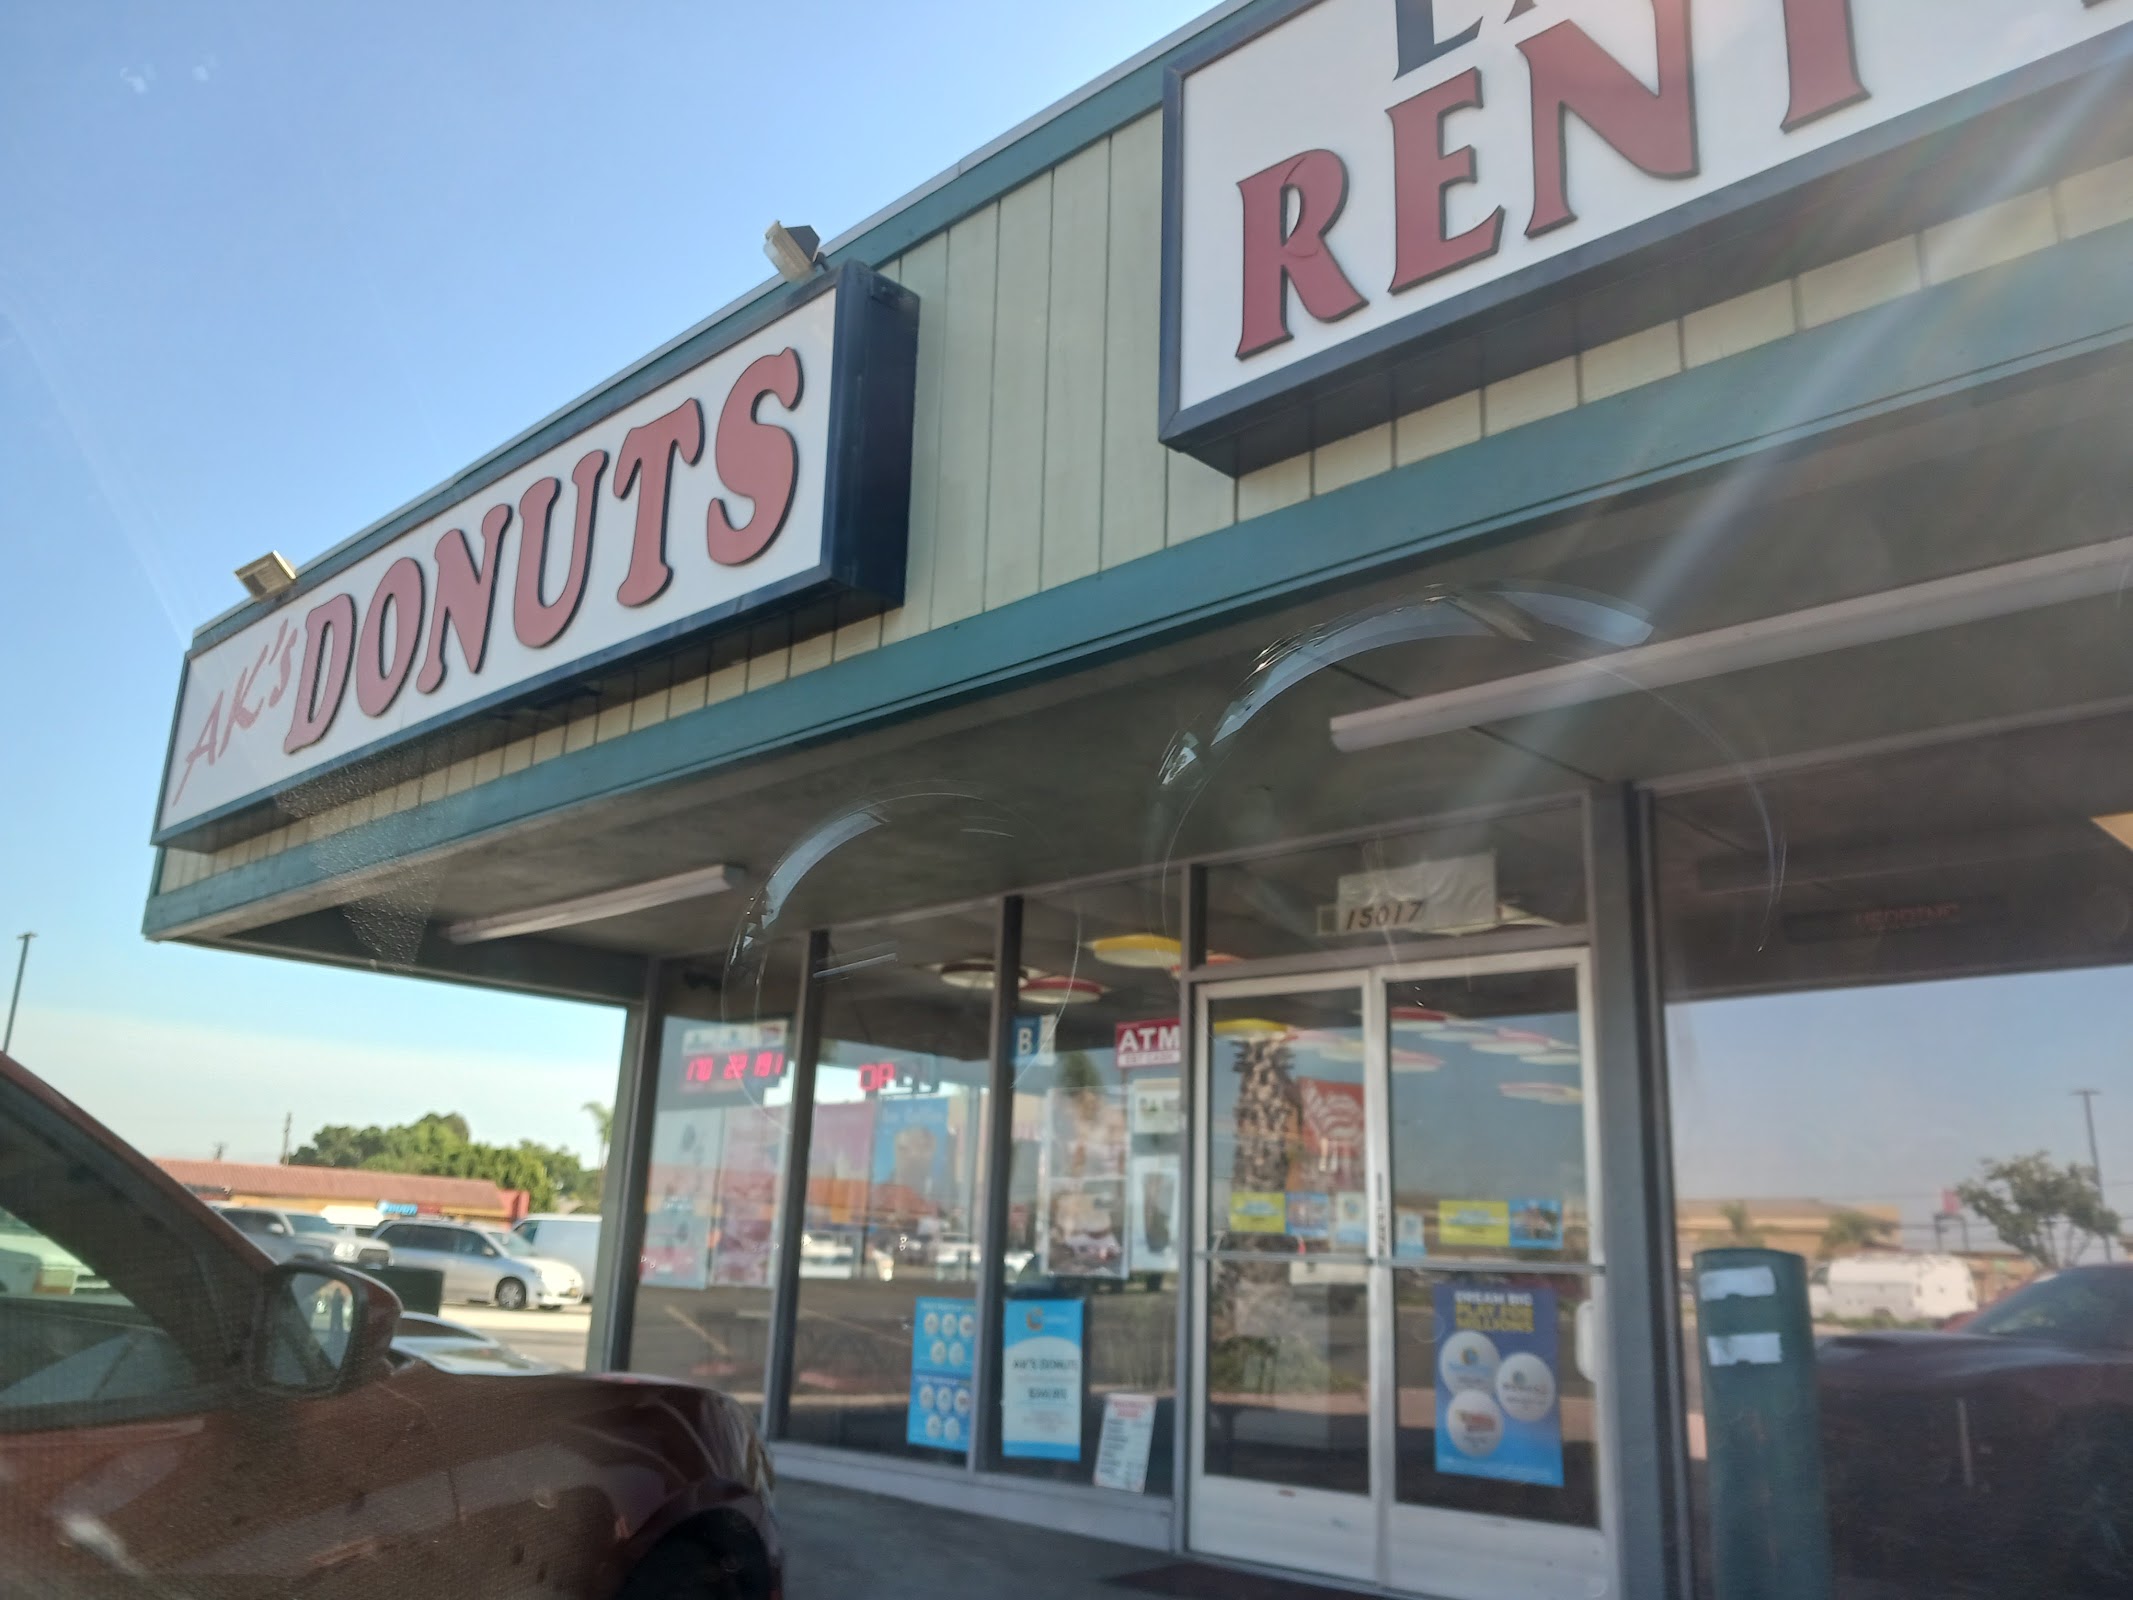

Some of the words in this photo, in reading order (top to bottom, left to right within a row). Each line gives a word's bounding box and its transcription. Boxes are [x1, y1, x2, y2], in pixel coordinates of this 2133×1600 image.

[283, 347, 804, 755] DONUTS
[1346, 899, 1423, 931] 15017
[1119, 1025, 1181, 1052] ATM
